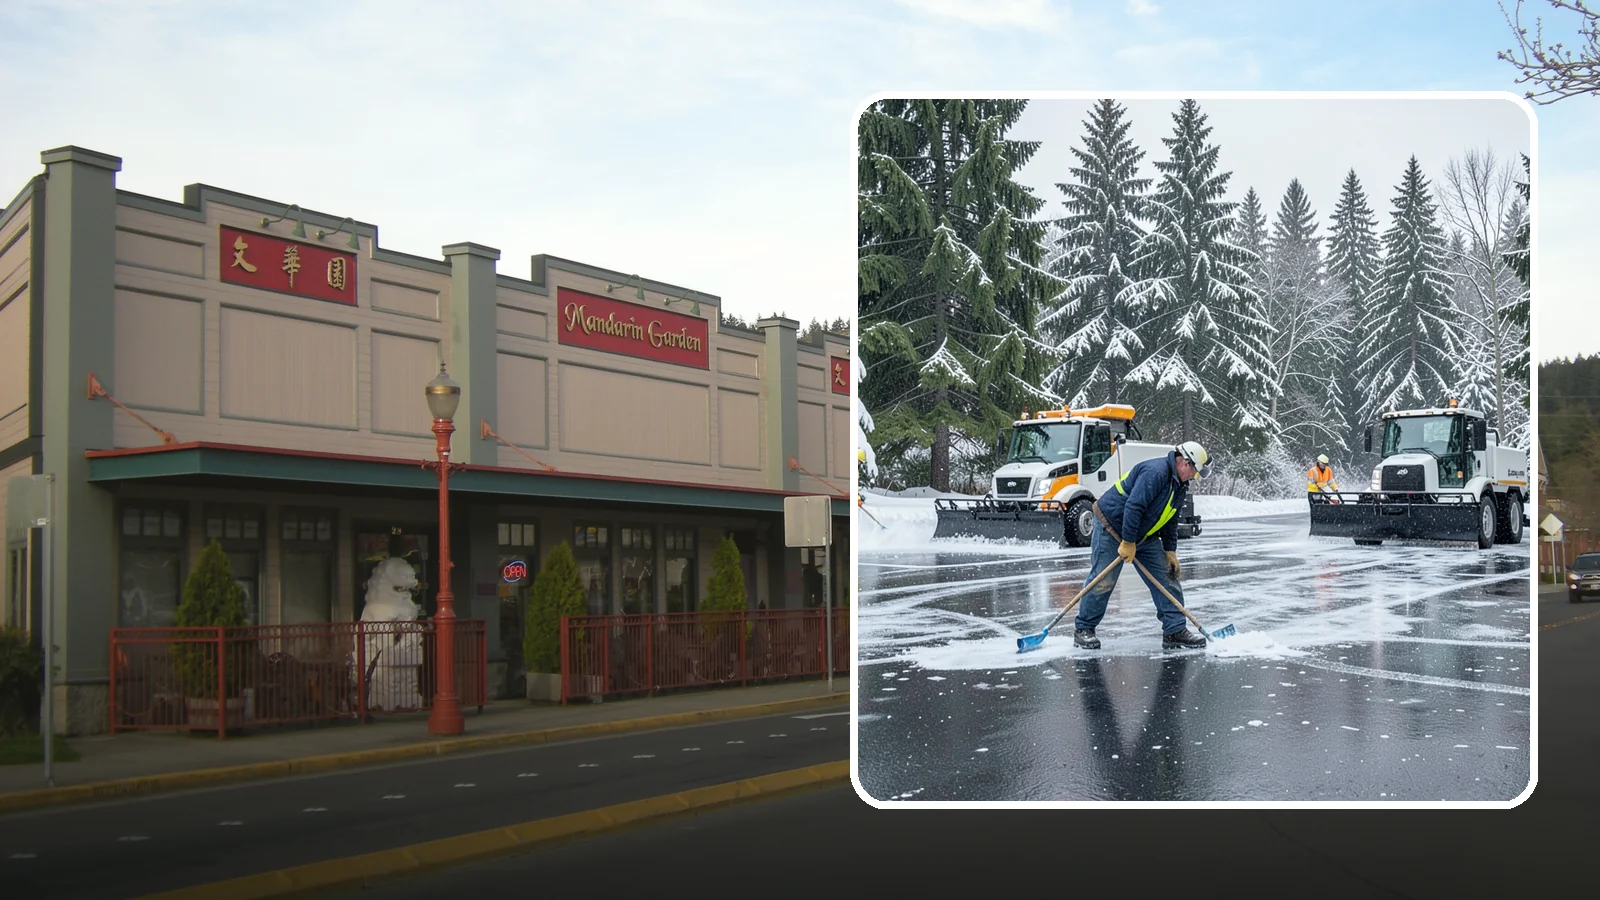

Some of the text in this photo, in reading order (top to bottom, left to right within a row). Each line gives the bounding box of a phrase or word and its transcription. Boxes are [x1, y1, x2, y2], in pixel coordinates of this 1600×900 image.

[230, 235, 347, 291] 文華園
[564, 302, 702, 353] Mandarin Garden
[503, 565, 527, 578] OPEN
